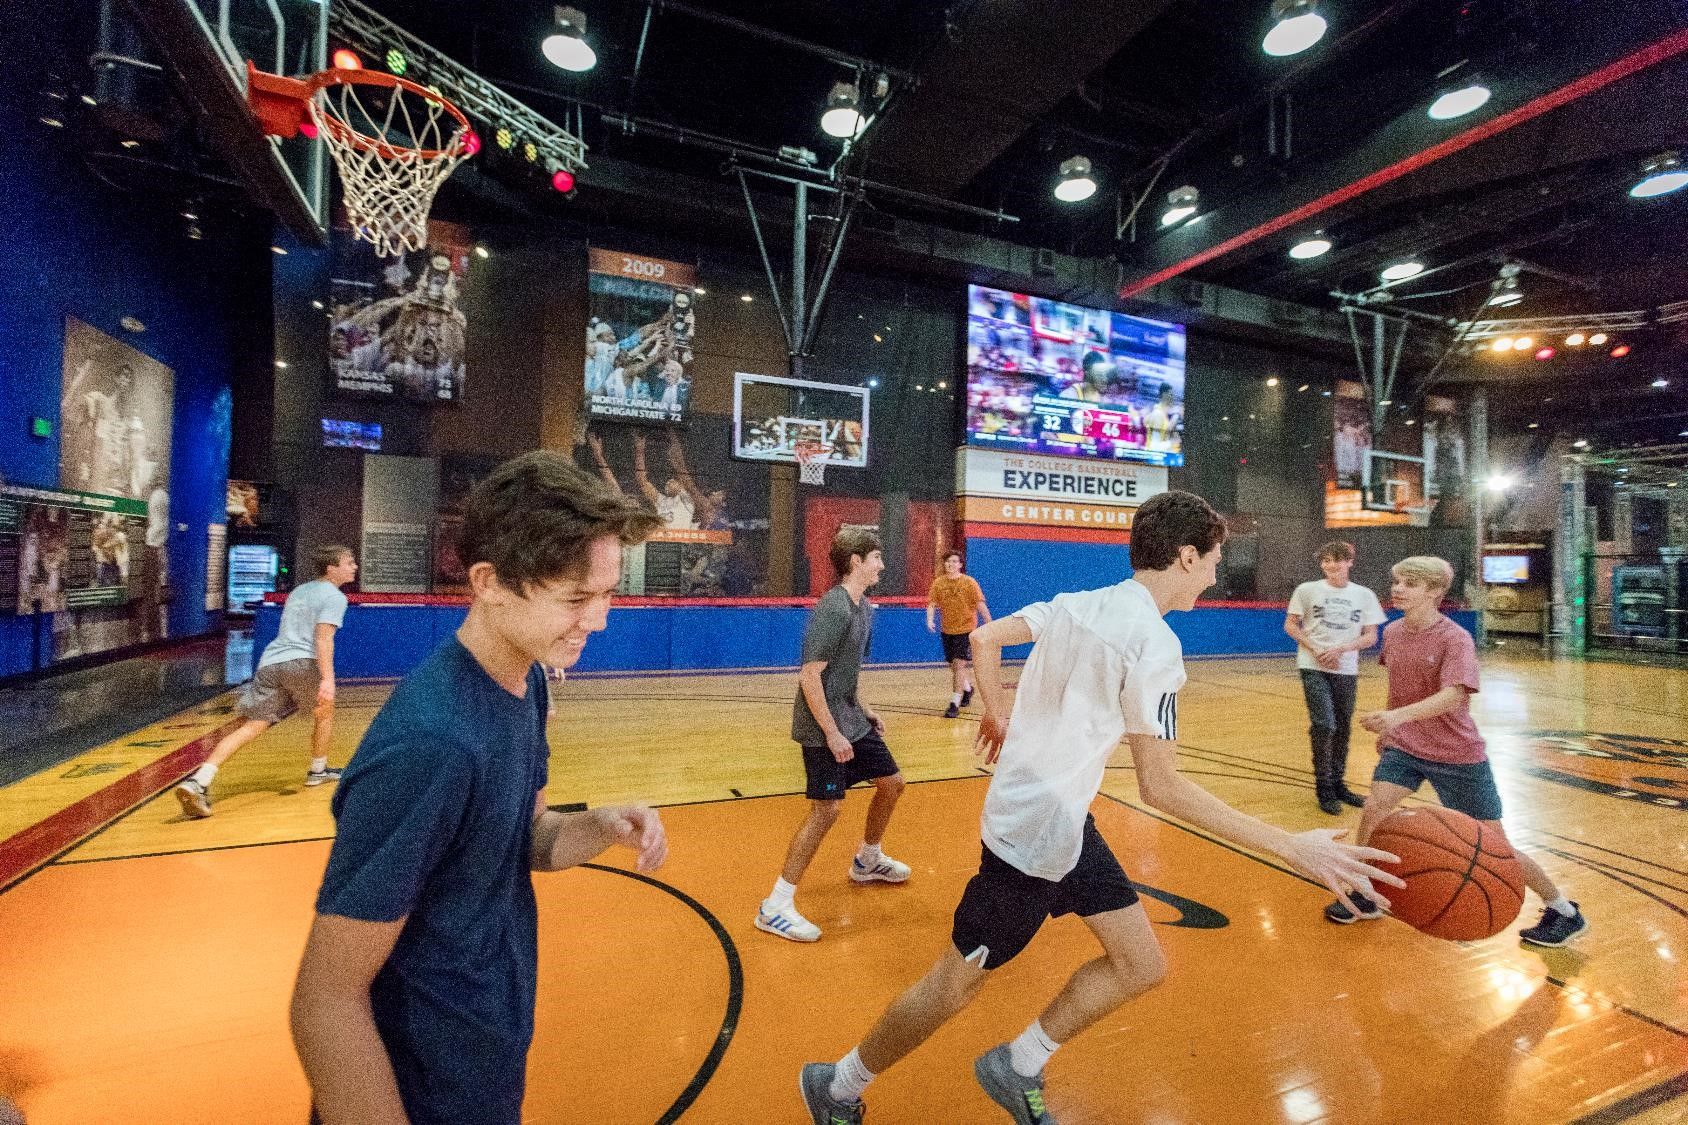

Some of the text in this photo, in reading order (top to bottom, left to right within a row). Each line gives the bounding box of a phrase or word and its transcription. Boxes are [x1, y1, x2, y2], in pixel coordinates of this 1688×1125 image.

[623, 258, 665, 277] 2009
[591, 395, 623, 406] NORTH
[624, 398, 669, 412] CAROLINA
[591, 405, 682, 422] MICHIGAN STATE 72
[1043, 415, 1061, 431] 32
[1101, 423, 1120, 437] 46
[1004, 458, 1137, 478] THE COLLEGE BASKETBALL
[1003, 470, 1137, 497] EXPERIENCE
[1002, 504, 1075, 521] CENTER
